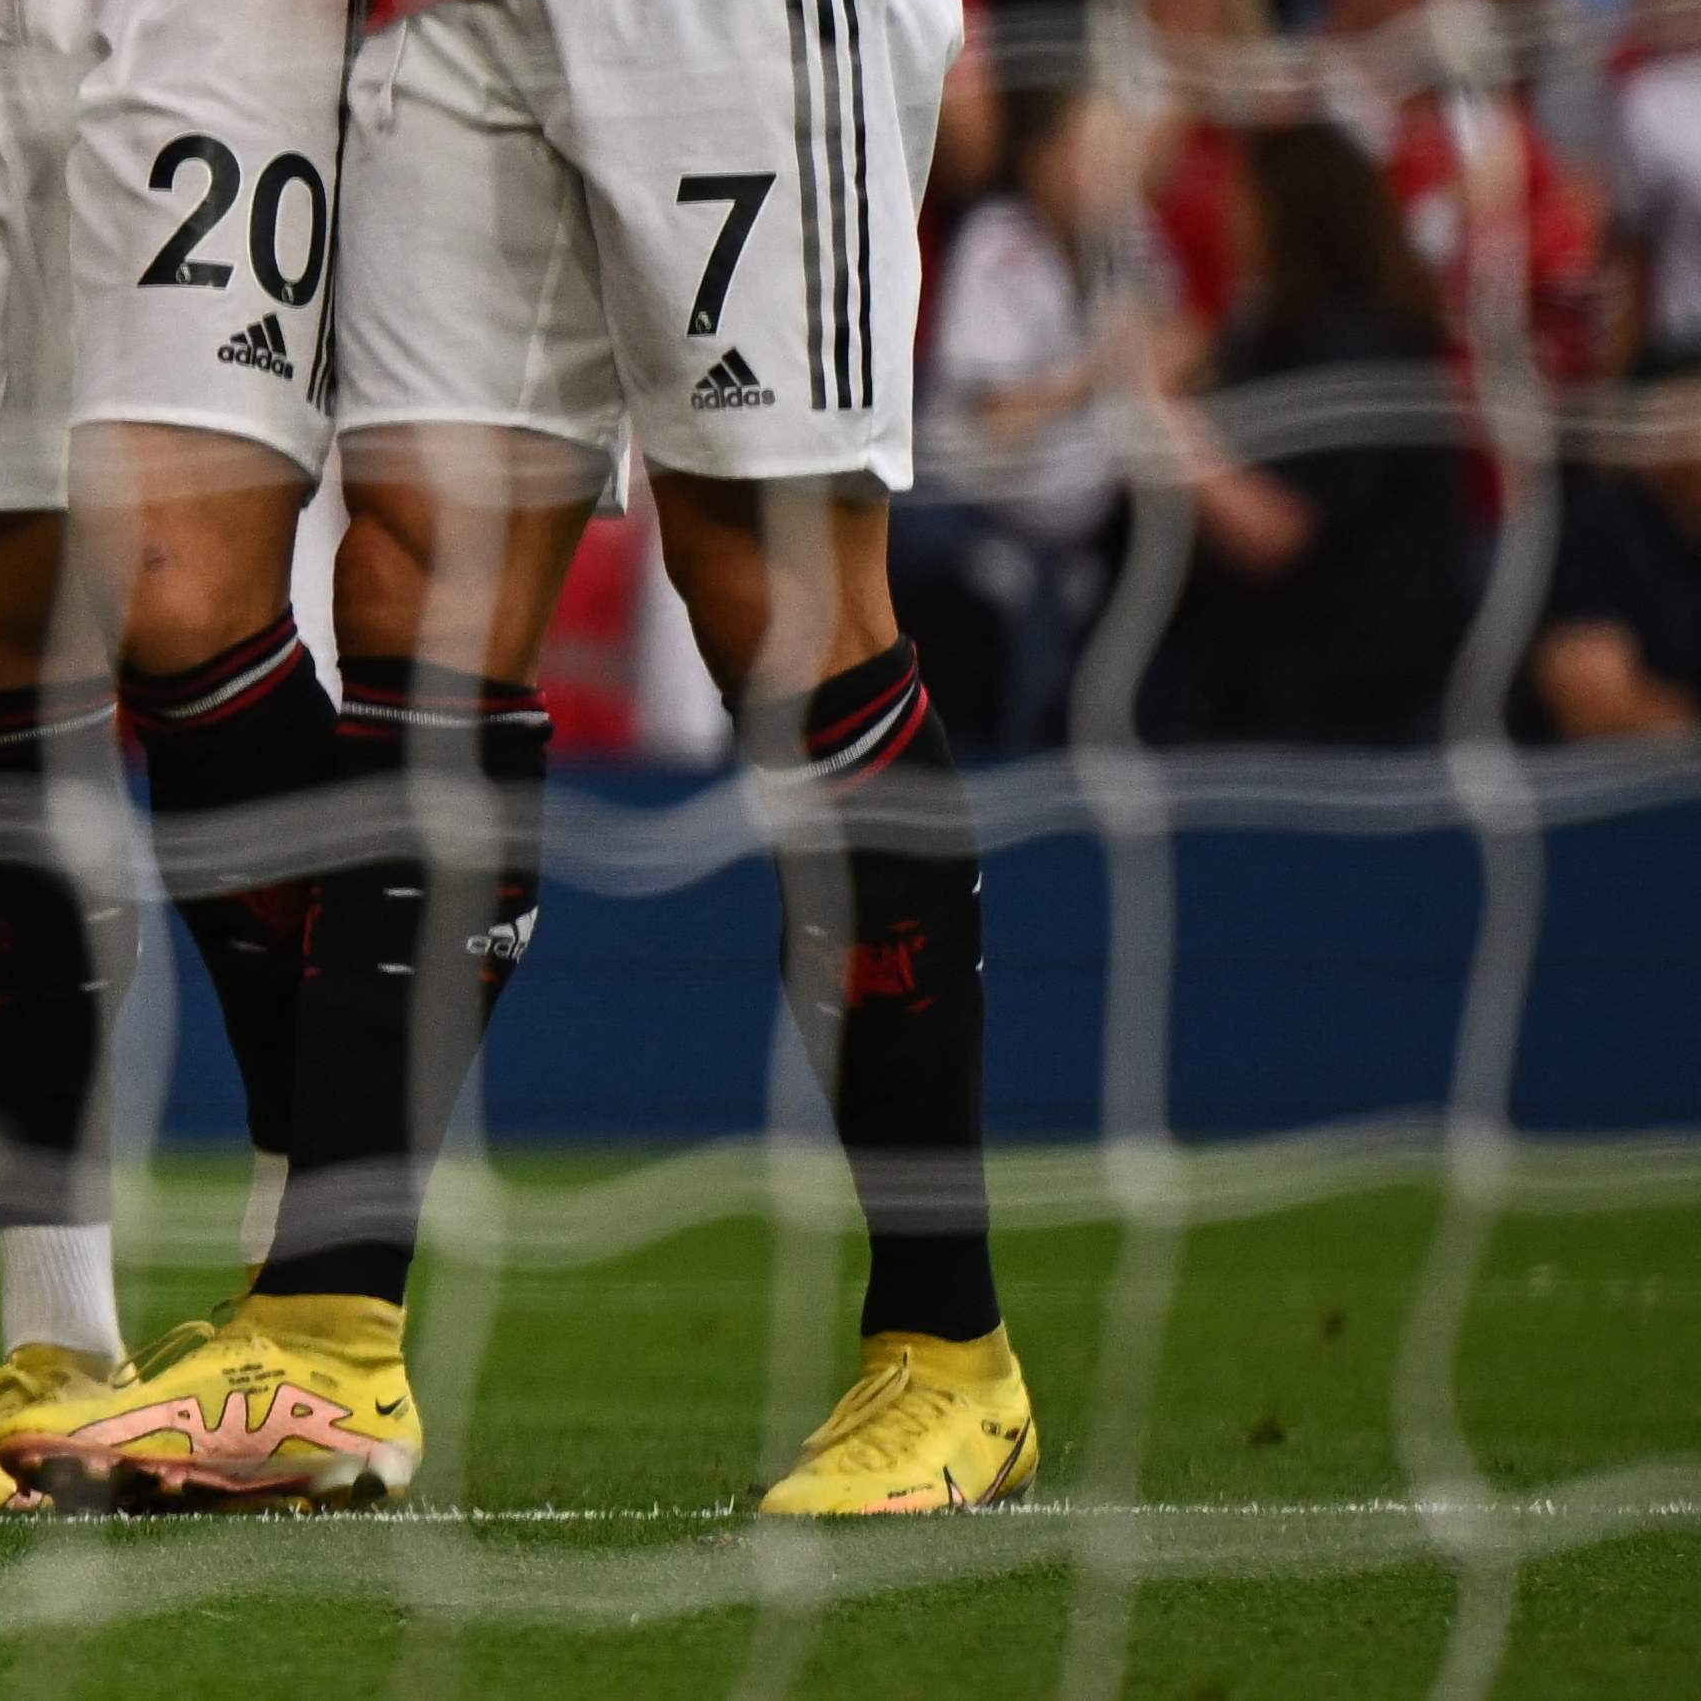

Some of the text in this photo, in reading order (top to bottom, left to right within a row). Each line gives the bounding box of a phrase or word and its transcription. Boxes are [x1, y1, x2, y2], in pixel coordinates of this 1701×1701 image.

[137, 133, 329, 309] 20
[675, 171, 778, 338] 7
[216, 343, 294, 382] adidas
[690, 386, 776, 411] adidas
